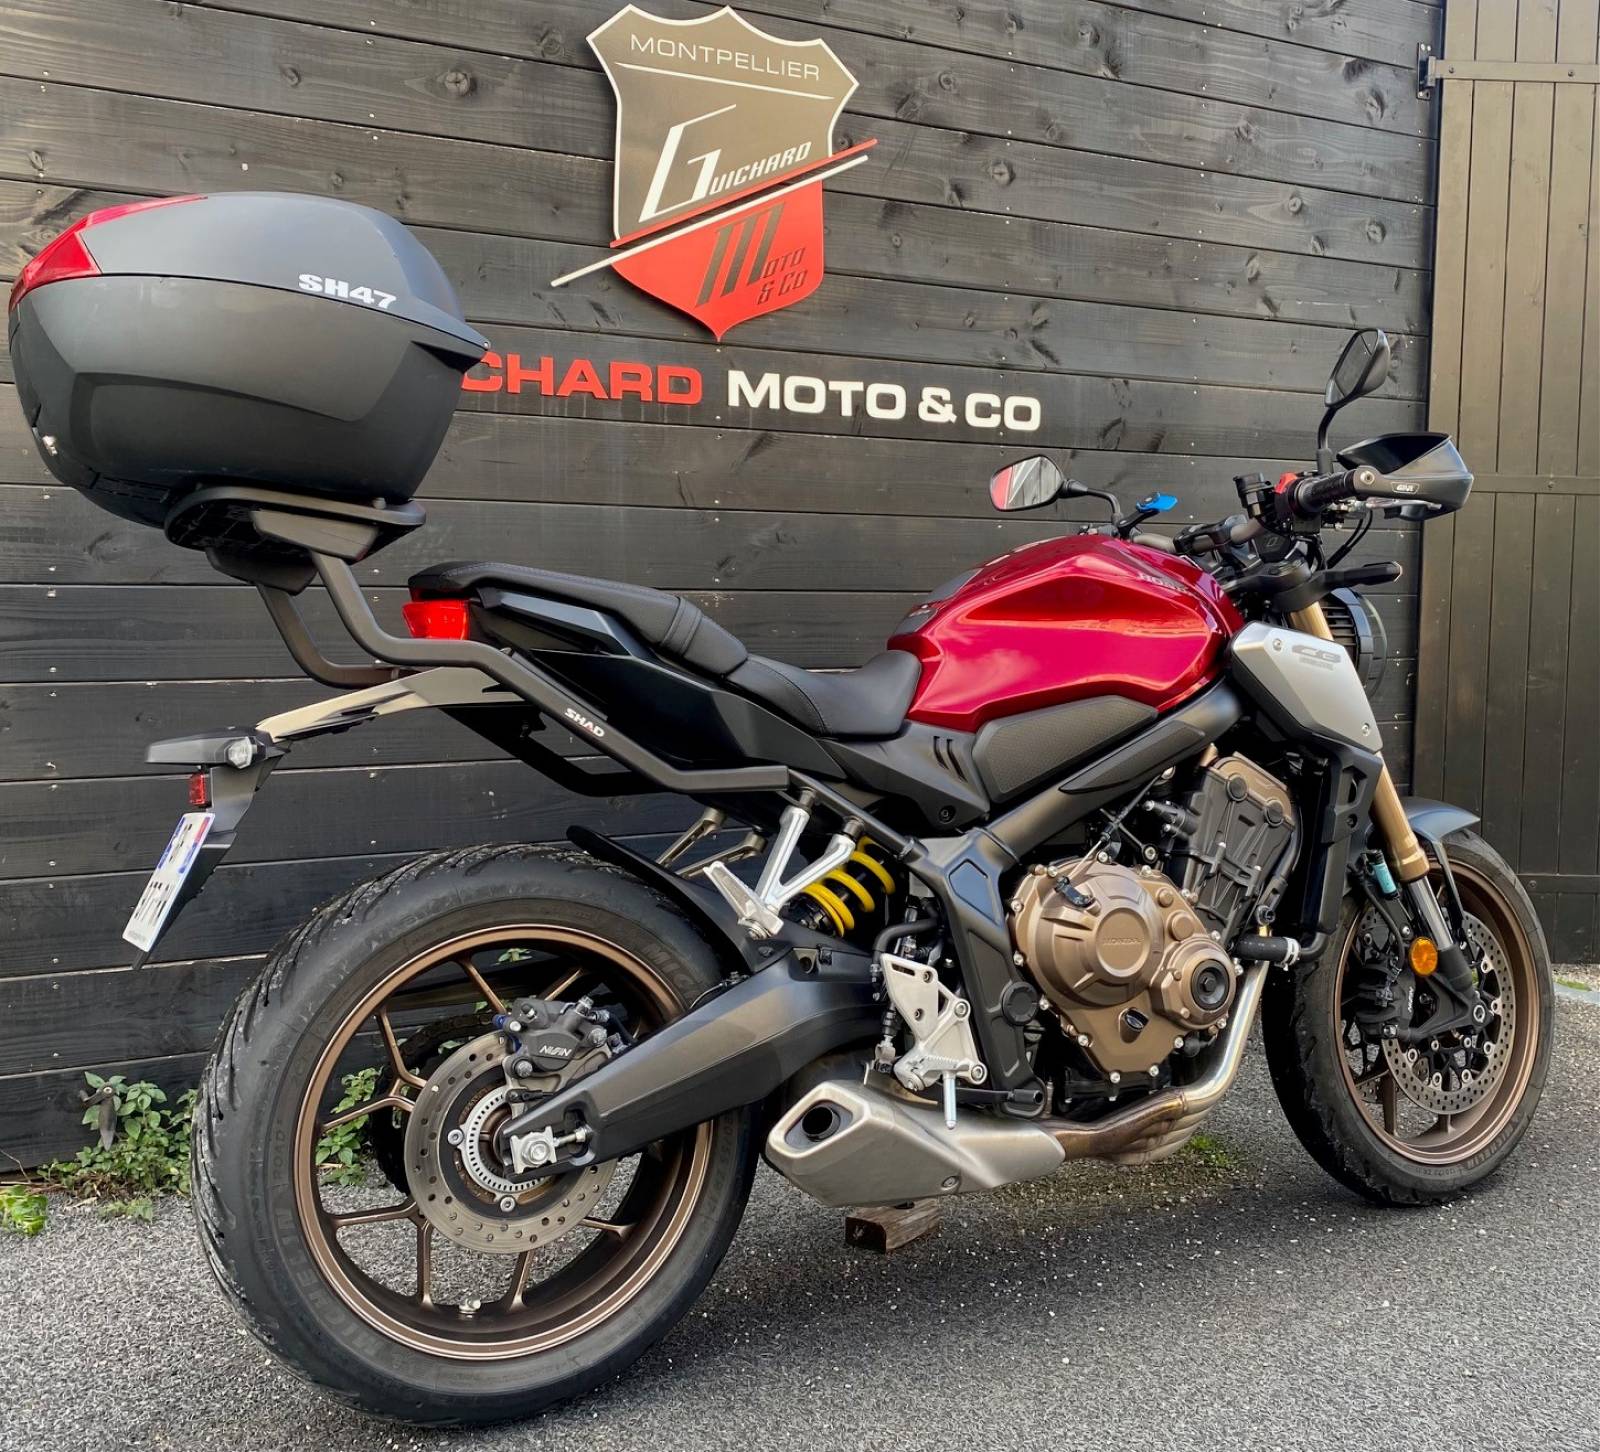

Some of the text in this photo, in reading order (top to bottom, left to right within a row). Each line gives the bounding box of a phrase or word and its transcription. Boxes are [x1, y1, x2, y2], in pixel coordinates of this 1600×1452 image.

[630, 33, 821, 81] MONTPELLIER
[638, 103, 812, 223] GUICHARD
[695, 202, 806, 308] MOTO
[298, 273, 397, 310] SH47
[756, 269, 808, 305] & CO
[727, 370, 907, 419] MOTO
[917, 387, 957, 424] &
[964, 392, 1041, 431] CO
[564, 707, 605, 738] SHAD
